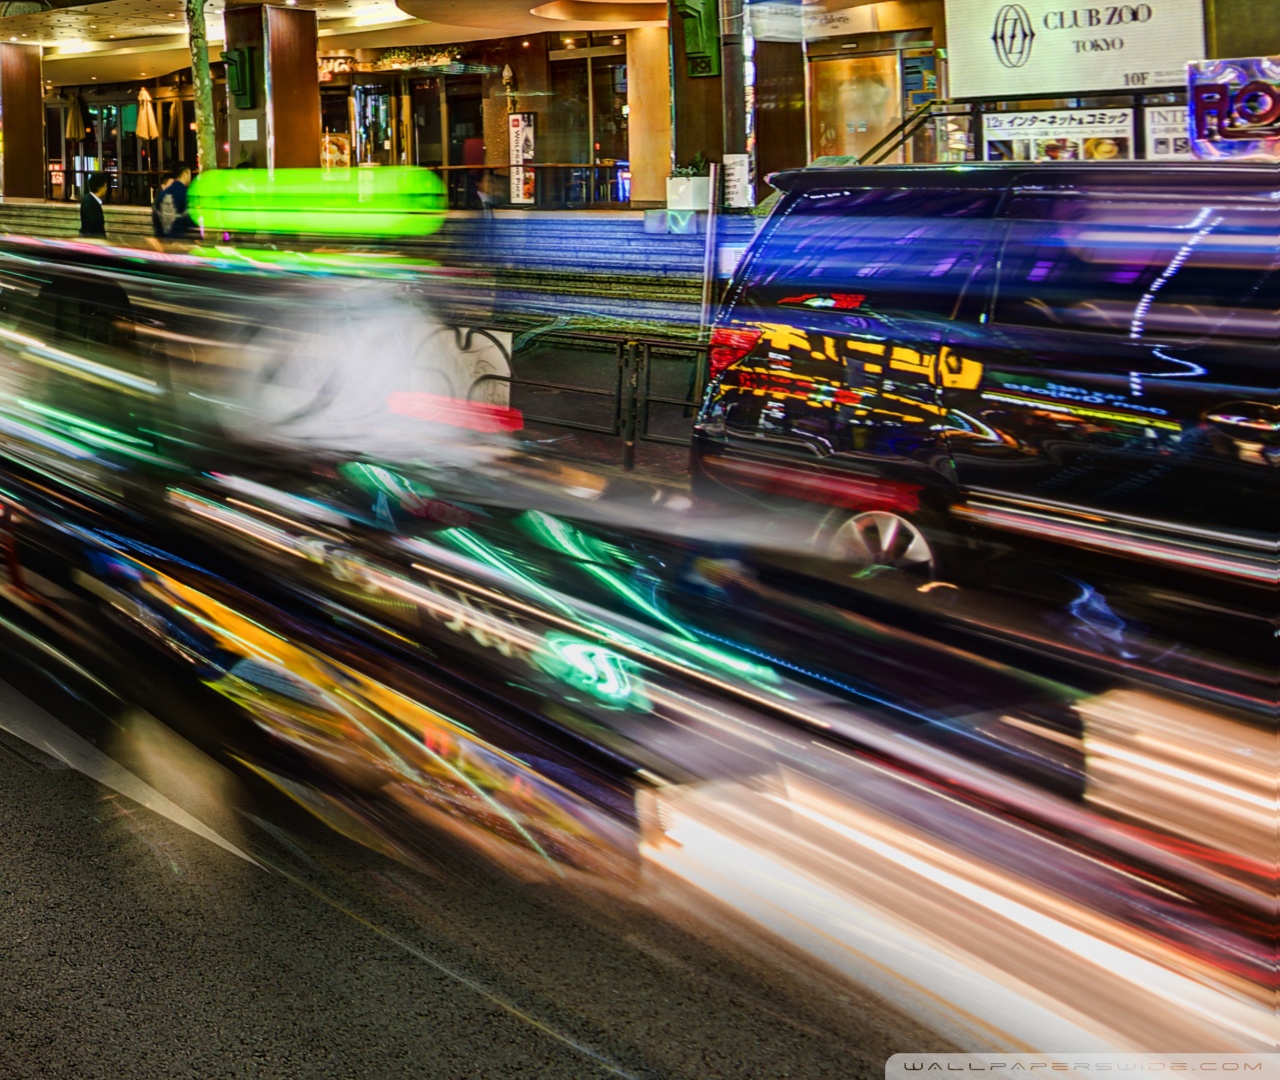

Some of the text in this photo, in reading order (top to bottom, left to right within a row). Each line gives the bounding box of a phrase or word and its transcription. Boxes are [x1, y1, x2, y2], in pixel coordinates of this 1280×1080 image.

[1044, 3, 1153, 31] CLUB ZOO
[1072, 37, 1124, 53] TOKYO
[1124, 71, 1150, 86] 10F
